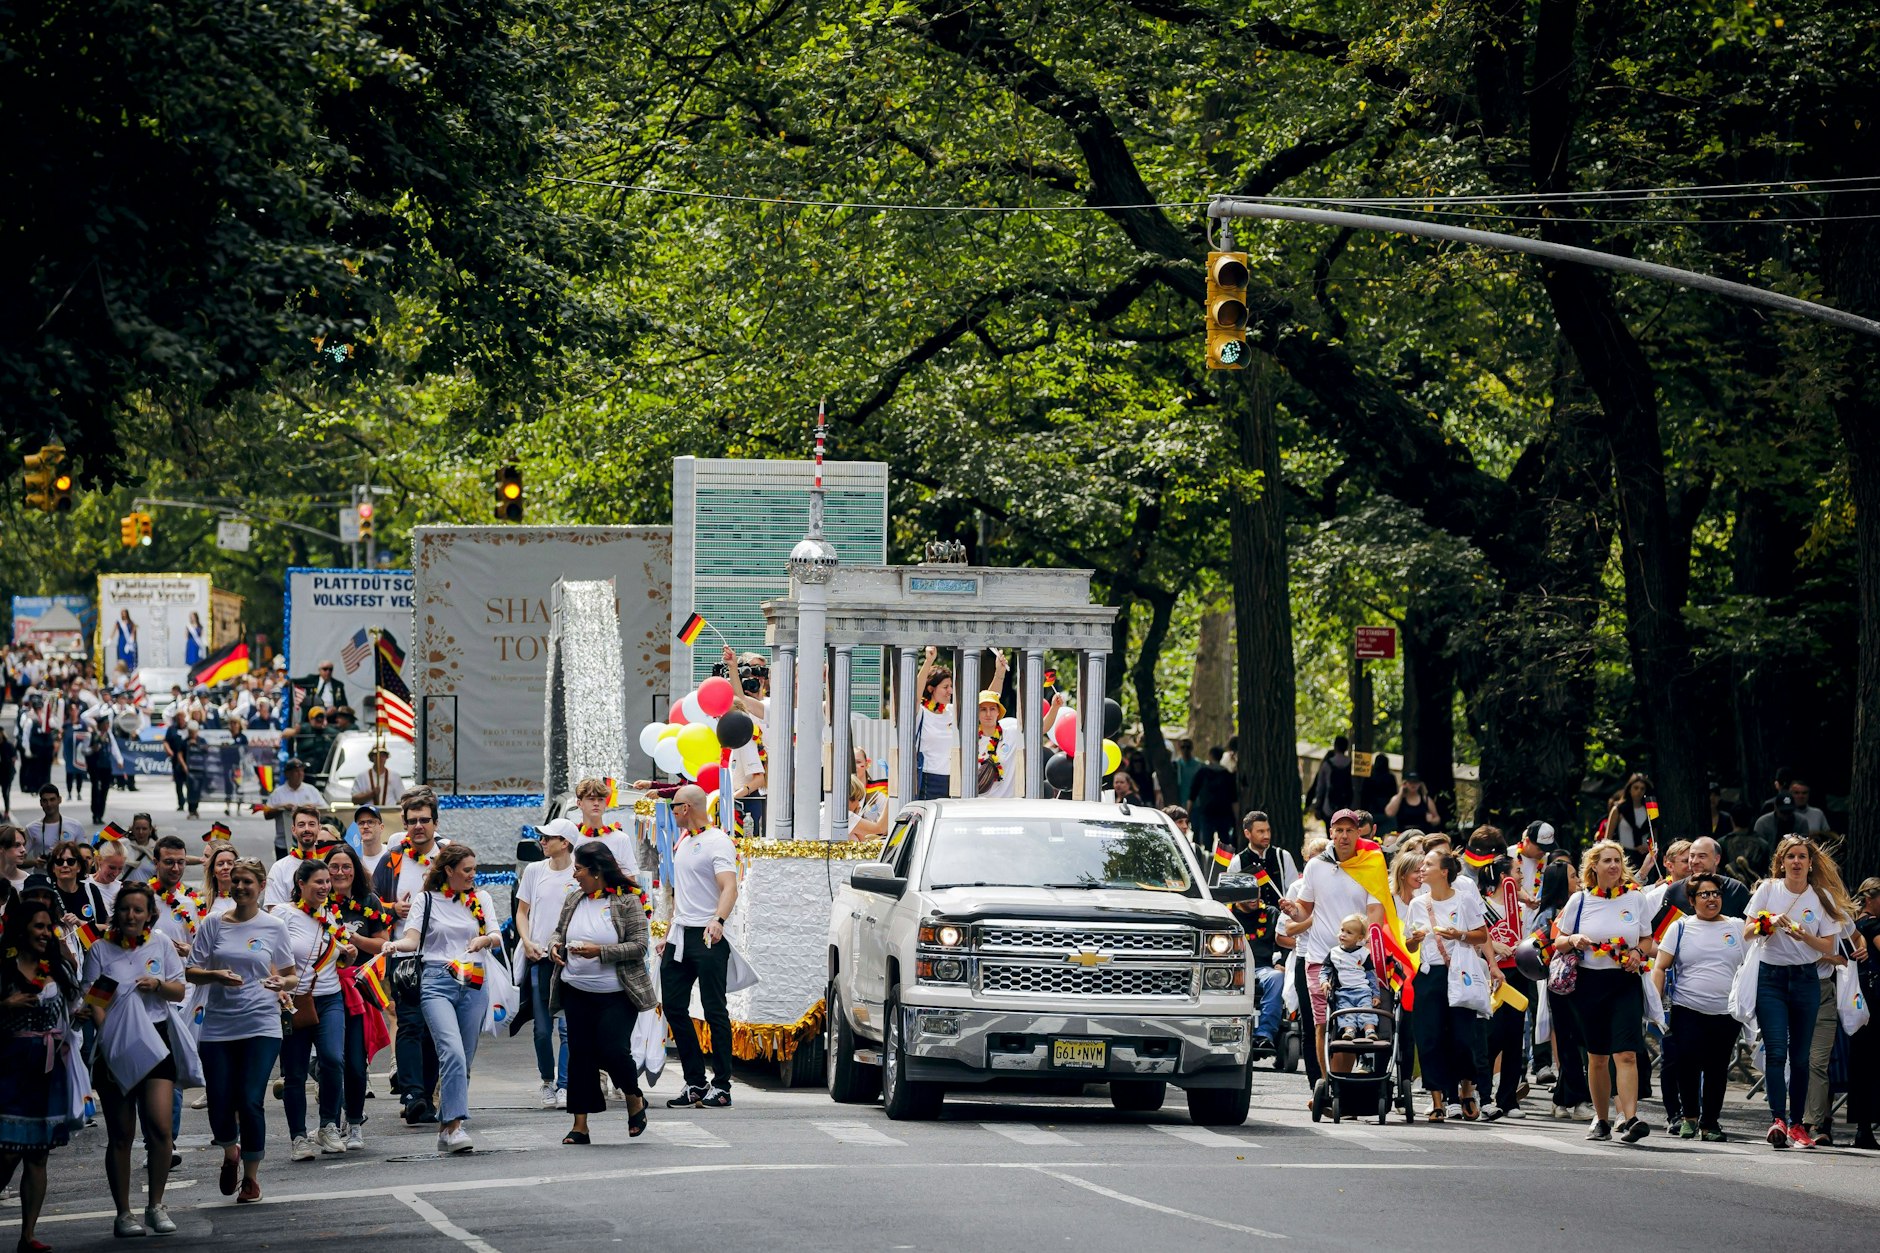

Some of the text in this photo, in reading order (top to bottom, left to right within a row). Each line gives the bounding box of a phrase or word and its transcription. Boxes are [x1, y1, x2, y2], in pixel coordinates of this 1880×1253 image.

[313, 594, 385, 606] VOLKSFEST
[1056, 1046, 1103, 1061] G61 NVM
